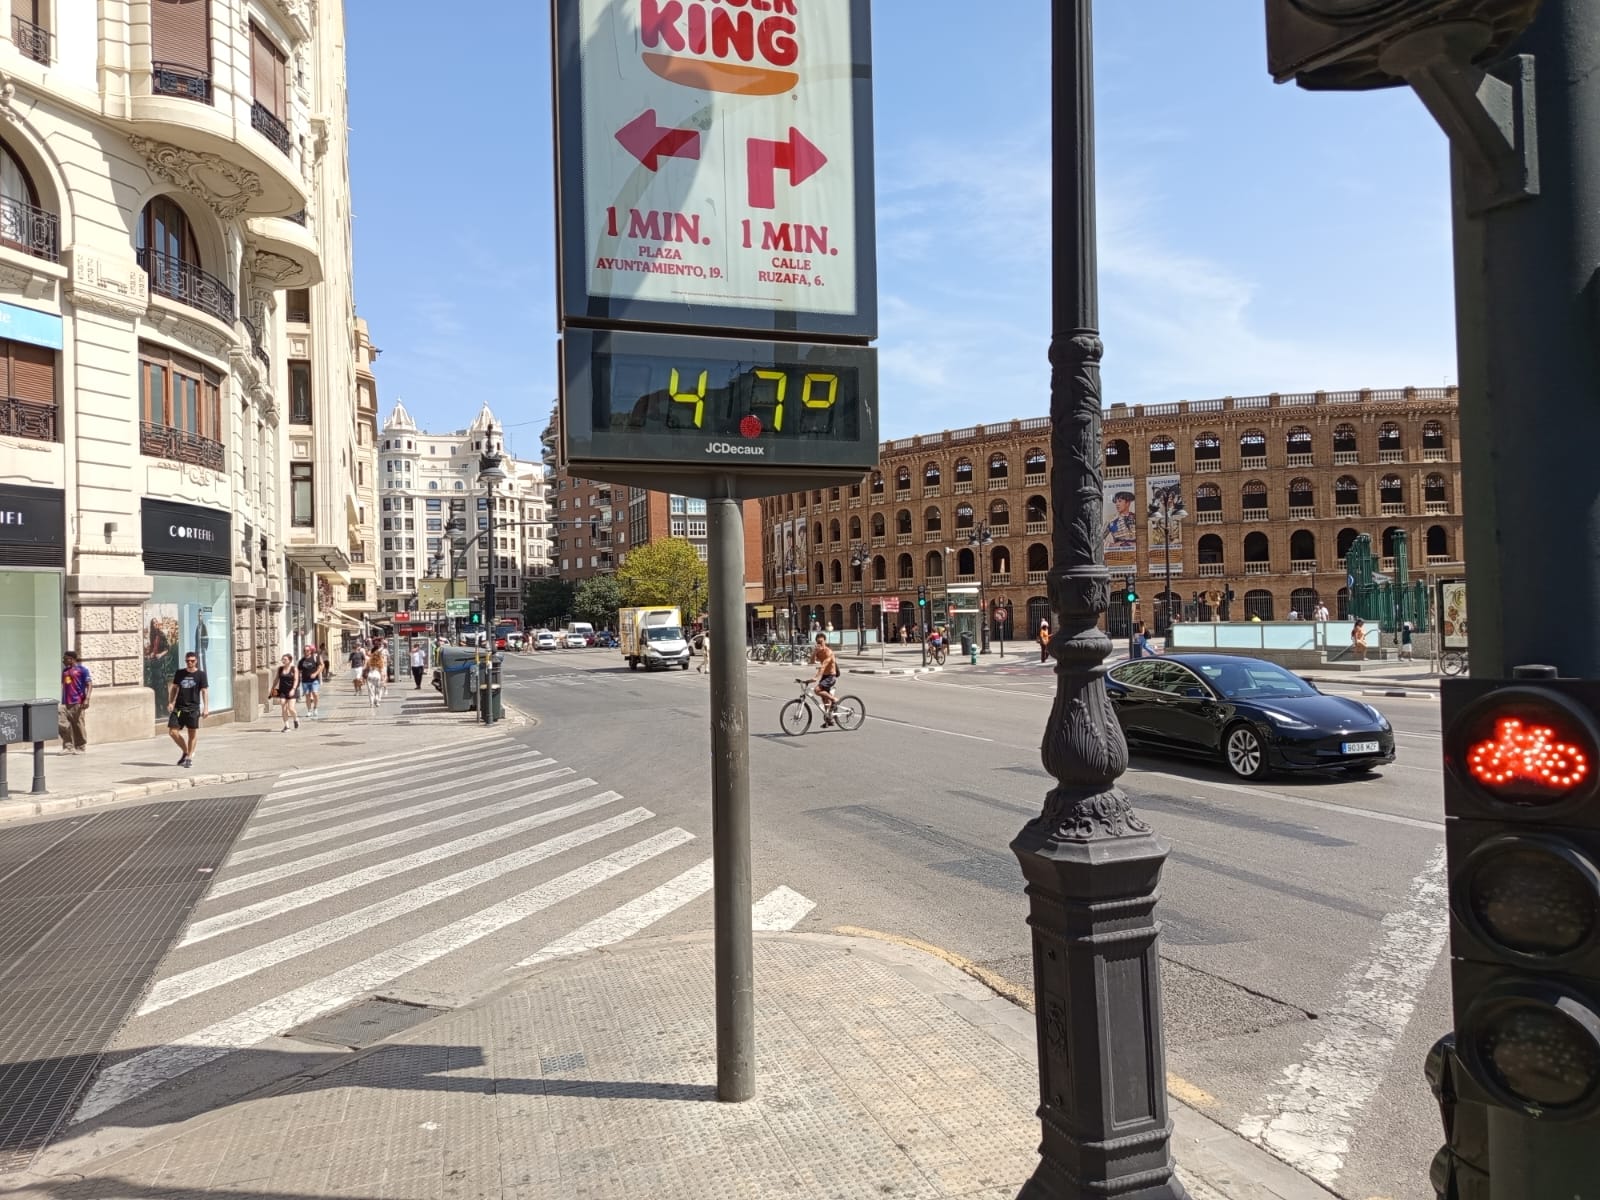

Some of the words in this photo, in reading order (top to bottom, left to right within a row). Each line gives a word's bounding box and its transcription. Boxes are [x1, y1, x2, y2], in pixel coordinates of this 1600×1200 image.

[641, 0, 799, 66] KING
[606, 206, 618, 237] 1
[628, 208, 711, 246] MIN.
[741, 219, 752, 249] 1
[762, 221, 838, 256] MIN.
[638, 245, 682, 261] PLAZA
[596, 257, 707, 279] AYUNTAMIENTO,
[708, 266, 724, 280] 19.
[771, 257, 812, 271] CALLE
[758, 270, 812, 288] RUZAFA,
[814, 275, 825, 287] 6.
[705, 441, 765, 456] JCDecaux
[169, 524, 215, 542] CORTEFIEL
